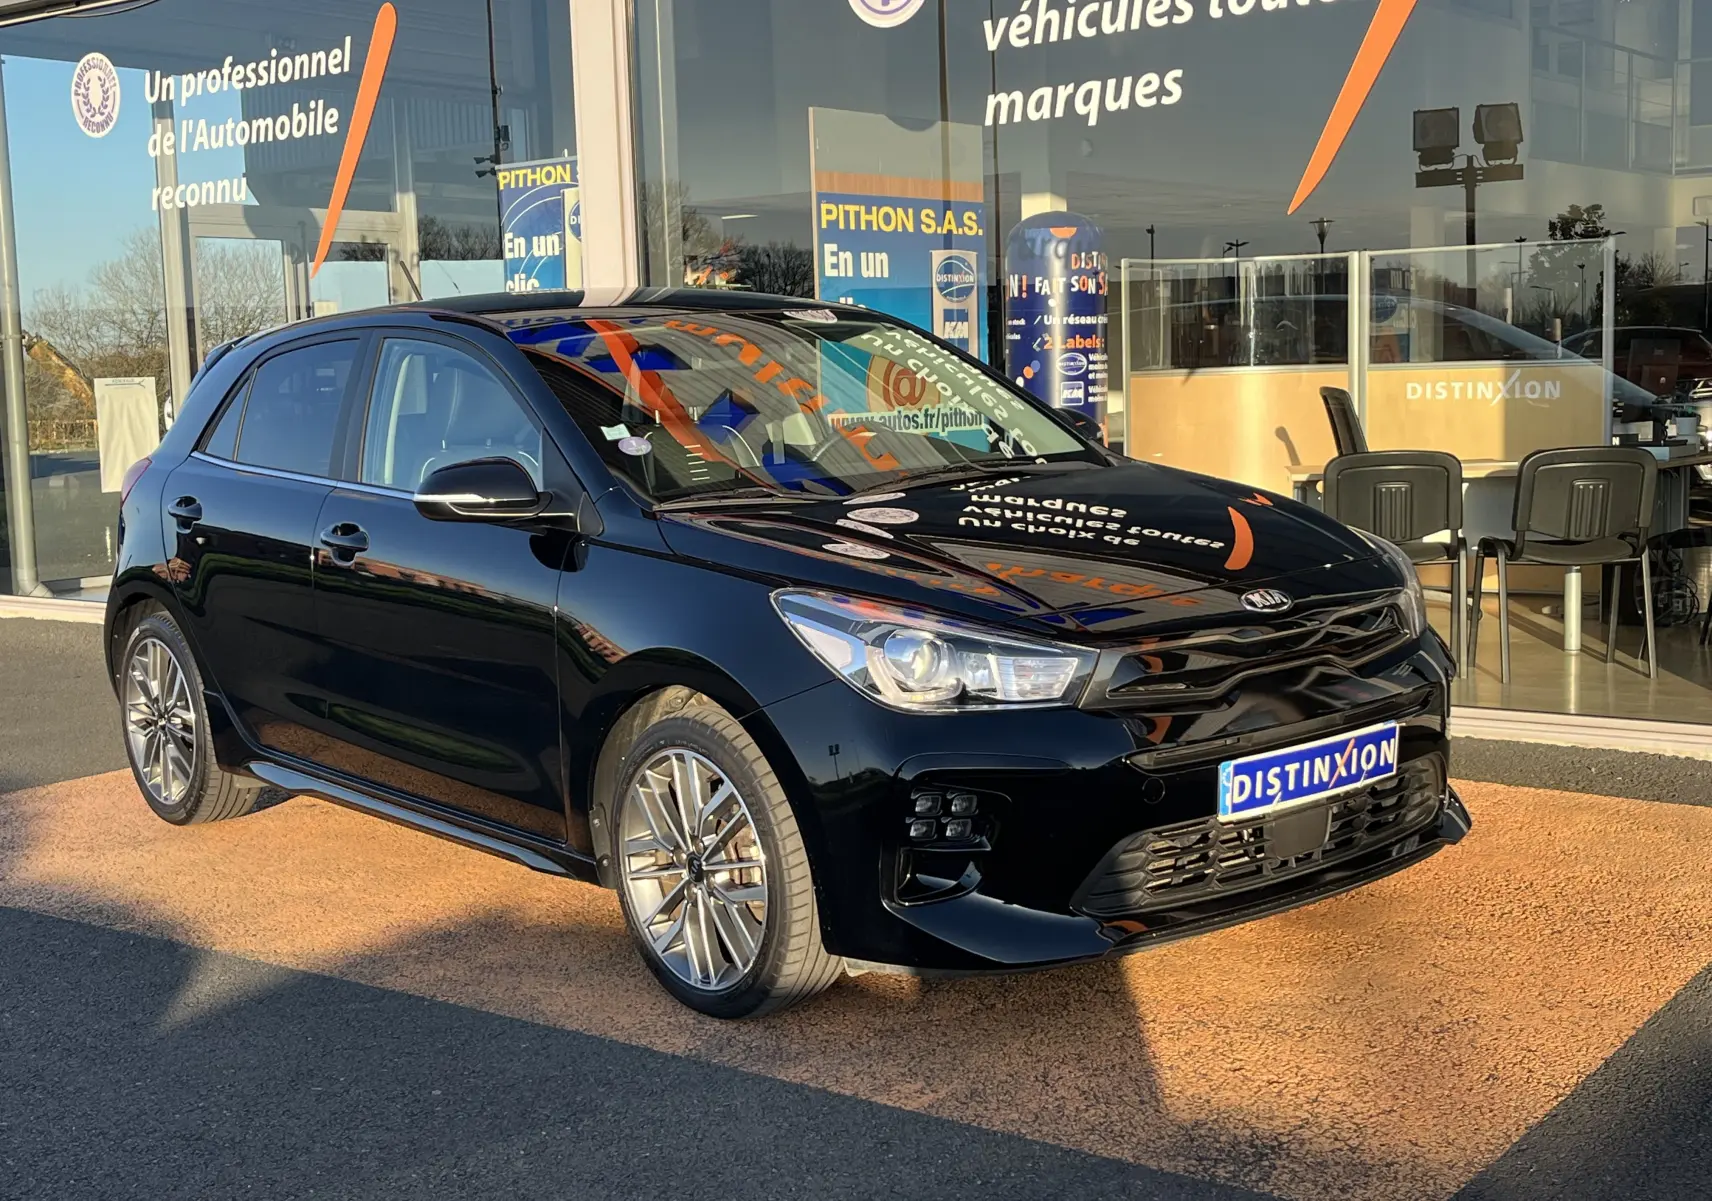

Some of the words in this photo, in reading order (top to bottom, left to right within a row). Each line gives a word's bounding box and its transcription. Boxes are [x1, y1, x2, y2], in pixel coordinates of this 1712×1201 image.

[983, 0, 1194, 51] véhicules
[73, 57, 117, 97] PROFESSIONNEL
[144, 70, 175, 103] Un
[181, 36, 352, 107] professionnel
[984, 68, 1184, 126] marques
[82, 112, 114, 134] RECONNU
[148, 124, 175, 157] de
[181, 99, 339, 153] l'Automobile
[497, 163, 571, 191] PITHON
[152, 177, 247, 211] reconnu
[820, 203, 914, 232] PITHON
[920, 208, 983, 236] S.A.S.
[504, 232, 526, 259] En
[532, 233, 560, 257] un
[824, 243, 853, 277] En
[860, 251, 889, 278] un
[936, 271, 974, 284] DISTINXION
[1071, 275, 1096, 295] SON
[943, 321, 969, 339] KM
[1406, 371, 1562, 403] DISTINXION
[831, 405, 983, 433] wwautos.fr/pithon
[1246, 589, 1289, 608] KIA
[1232, 738, 1396, 805] DISTINXION
